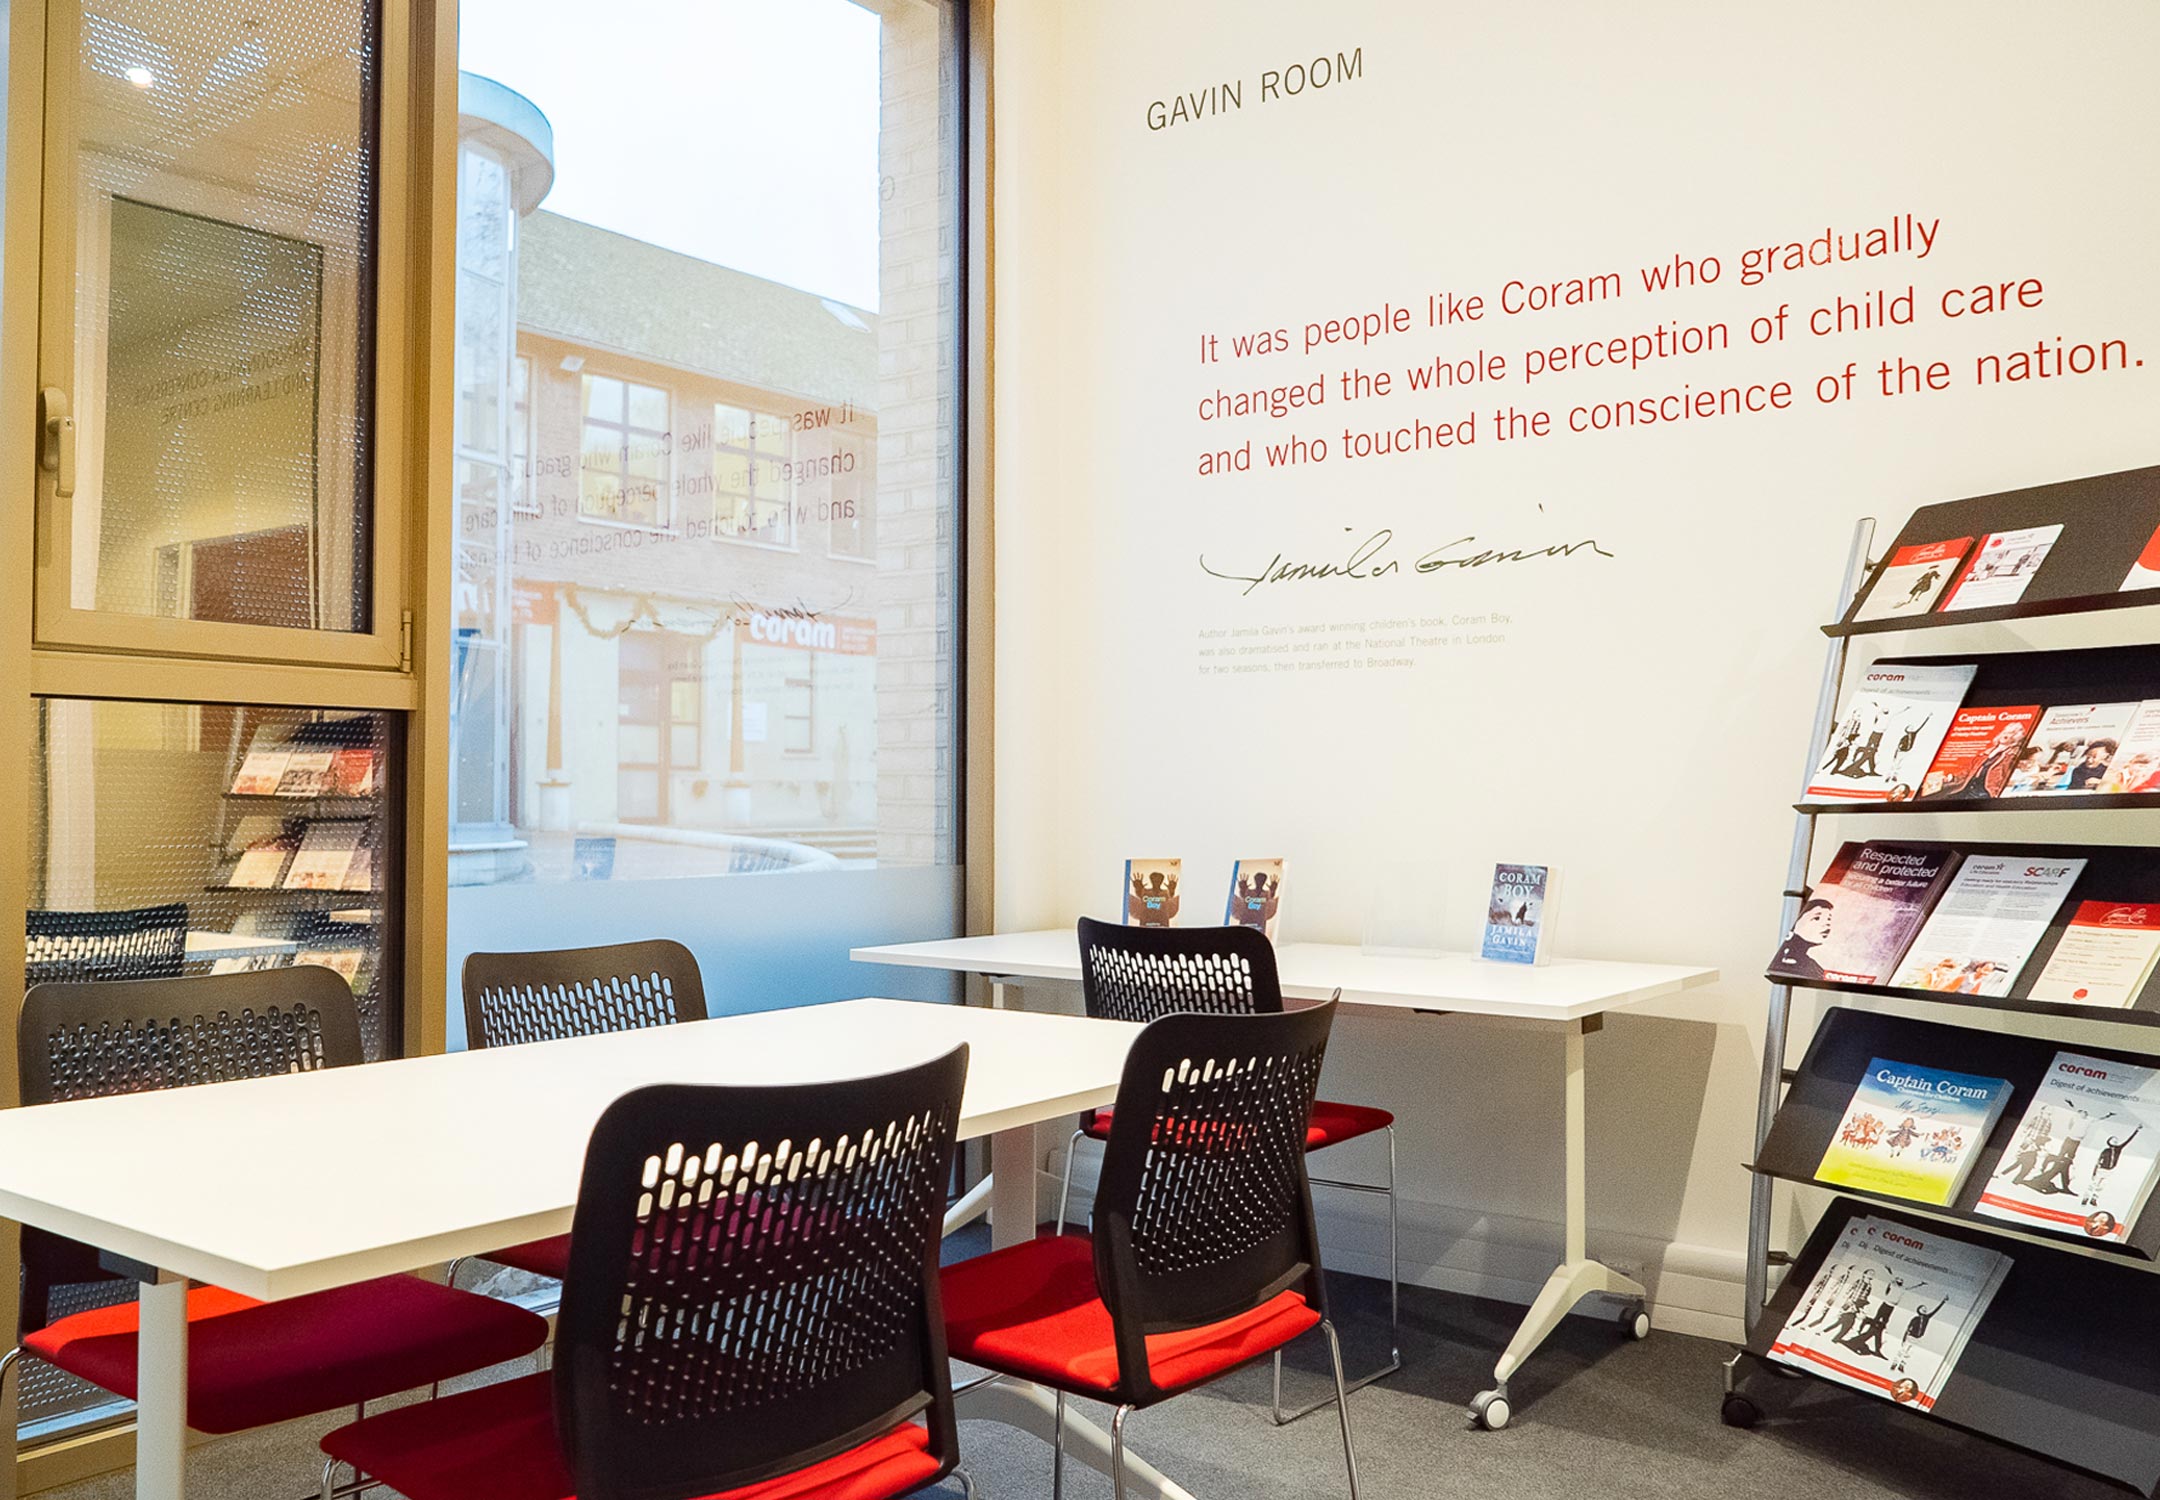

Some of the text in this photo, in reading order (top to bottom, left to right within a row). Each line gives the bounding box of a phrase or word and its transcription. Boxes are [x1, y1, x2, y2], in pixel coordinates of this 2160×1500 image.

[1147, 47, 1363, 131] GAVIN ROOM
[1200, 212, 1941, 364] It was people like Coram who gradually
[1199, 277, 2044, 421] changed the whole perception of child care
[1199, 335, 2145, 476] and who touched the conscience of the nation.
[750, 612, 836, 649] coram
[1198, 628, 1227, 639] Author
[1231, 626, 1259, 638] Jamila
[1262, 624, 1295, 636] Gavin's
[1296, 623, 1326, 634] award
[1328, 621, 1366, 633] winning
[1368, 618, 1417, 631] children's
[1451, 614, 1487, 626] Coram
[1198, 632, 1506, 657] was also dramatised and ran at the National Theatre in London
[1197, 663, 1211, 675] for
[1213, 663, 1230, 674] two
[1272, 660, 1295, 672] then
[1298, 658, 1350, 671] transferred
[1352, 657, 1364, 669] to
[1866, 673, 1905, 682] coram
[1958, 711, 2033, 725] Captain Coram
[1859, 847, 1928, 866] Respected
[1498, 871, 1542, 886] CORAM
[1852, 860, 1940, 878] and protected
[2023, 864, 2072, 879] SCARF
[1504, 882, 1535, 898] BOY
[1884, 878, 1907, 887] better
[1905, 880, 1929, 889] future
[1142, 894, 1167, 903] Coram
[1244, 894, 1267, 904] Coram
[1489, 924, 1533, 938] JAMILA
[1491, 933, 1527, 947] GAVIN
[2058, 1062, 2108, 1081] coram
[1876, 1068, 1934, 1091] Captain
[1935, 1079, 1989, 1100] Coram
[2049, 1077, 2076, 1090] Digest
[2075, 1083, 2087, 1091] of
[2086, 1086, 2141, 1102] achievements
[1882, 1229, 1926, 1251] coram
[1873, 1244, 1896, 1258] Digest
[1895, 1252, 1905, 1261] of
[1903, 1255, 1949, 1275] achievements
